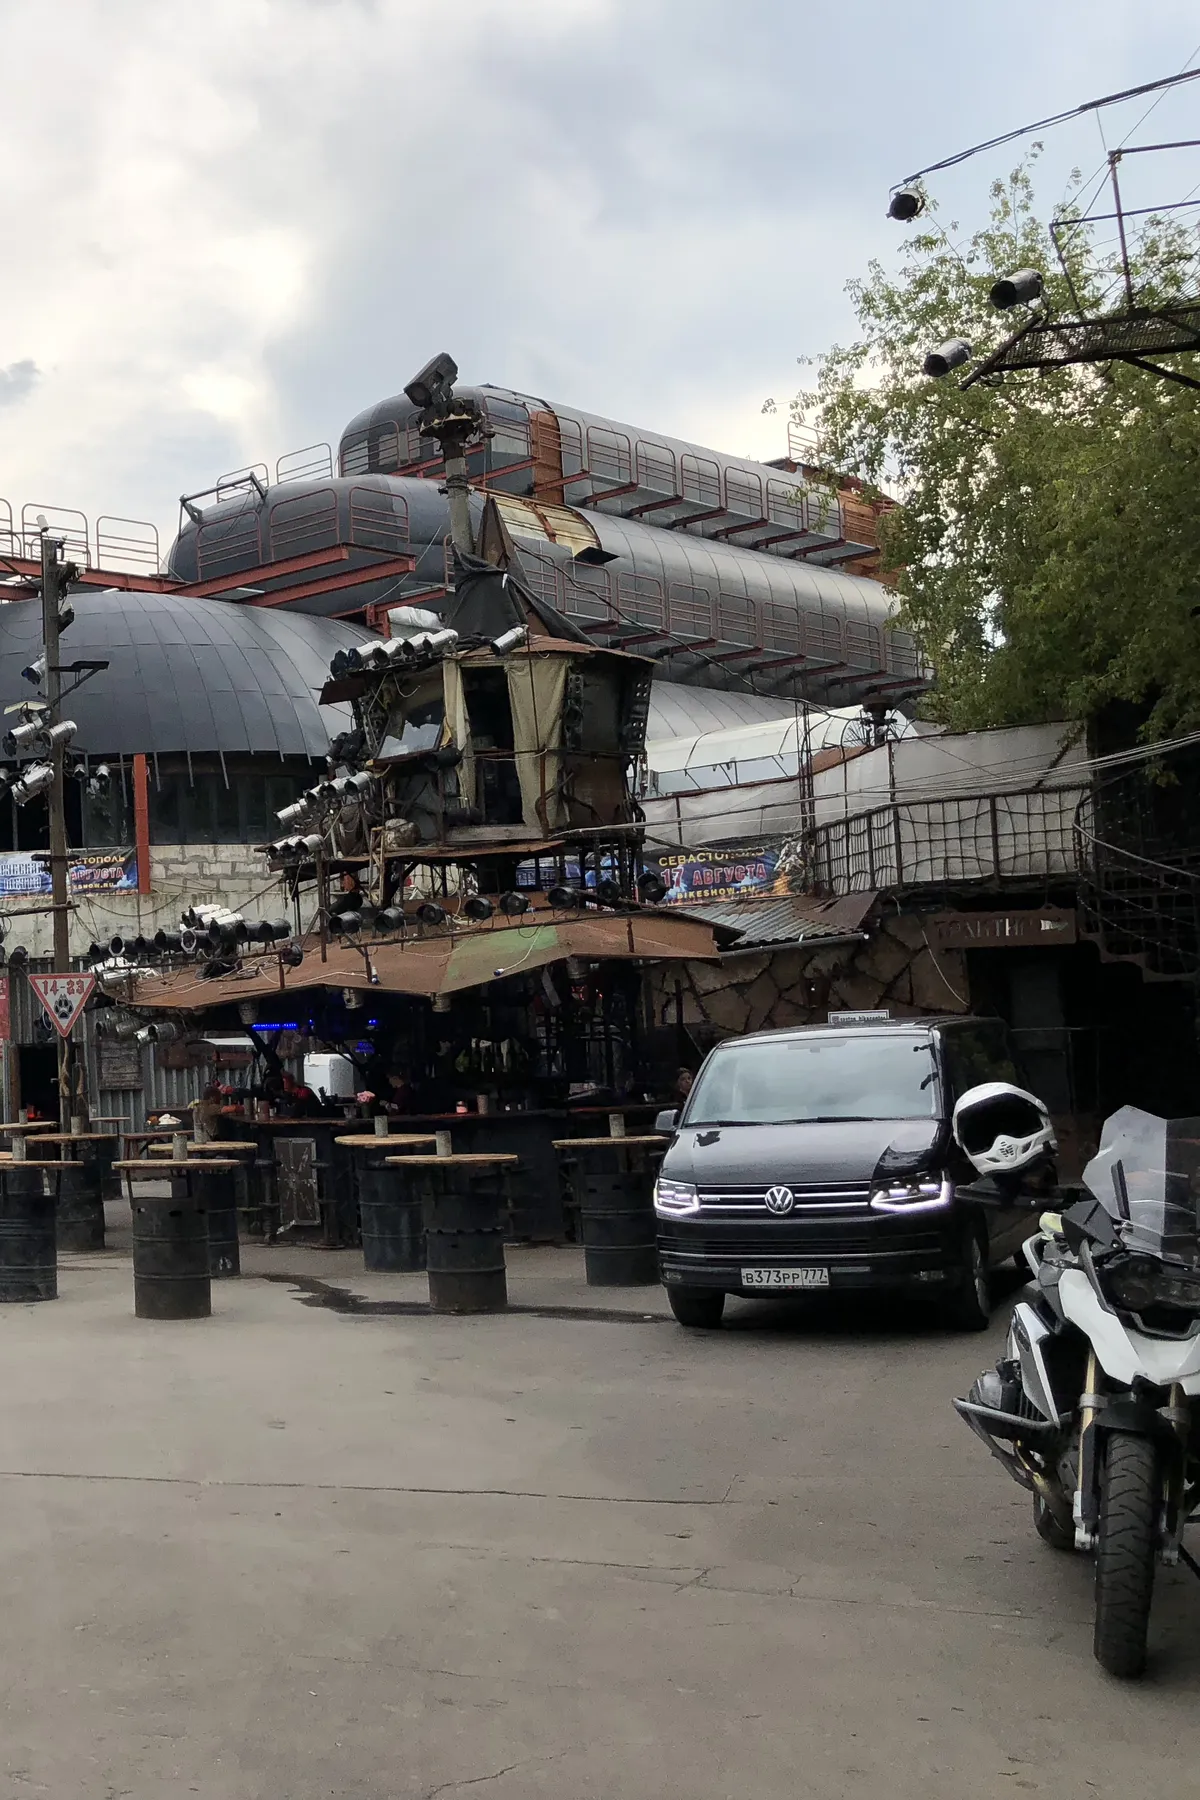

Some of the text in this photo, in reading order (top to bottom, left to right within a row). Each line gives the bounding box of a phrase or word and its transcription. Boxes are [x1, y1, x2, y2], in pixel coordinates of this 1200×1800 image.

[659, 848, 764, 867] СЕВАСТО
[661, 863, 767, 888] 17 АВГУСТА
[677, 885, 756, 899] BIKESHOW.RU
[42, 979, 85, 996] 14-23
[803, 1269, 824, 1280] 777
